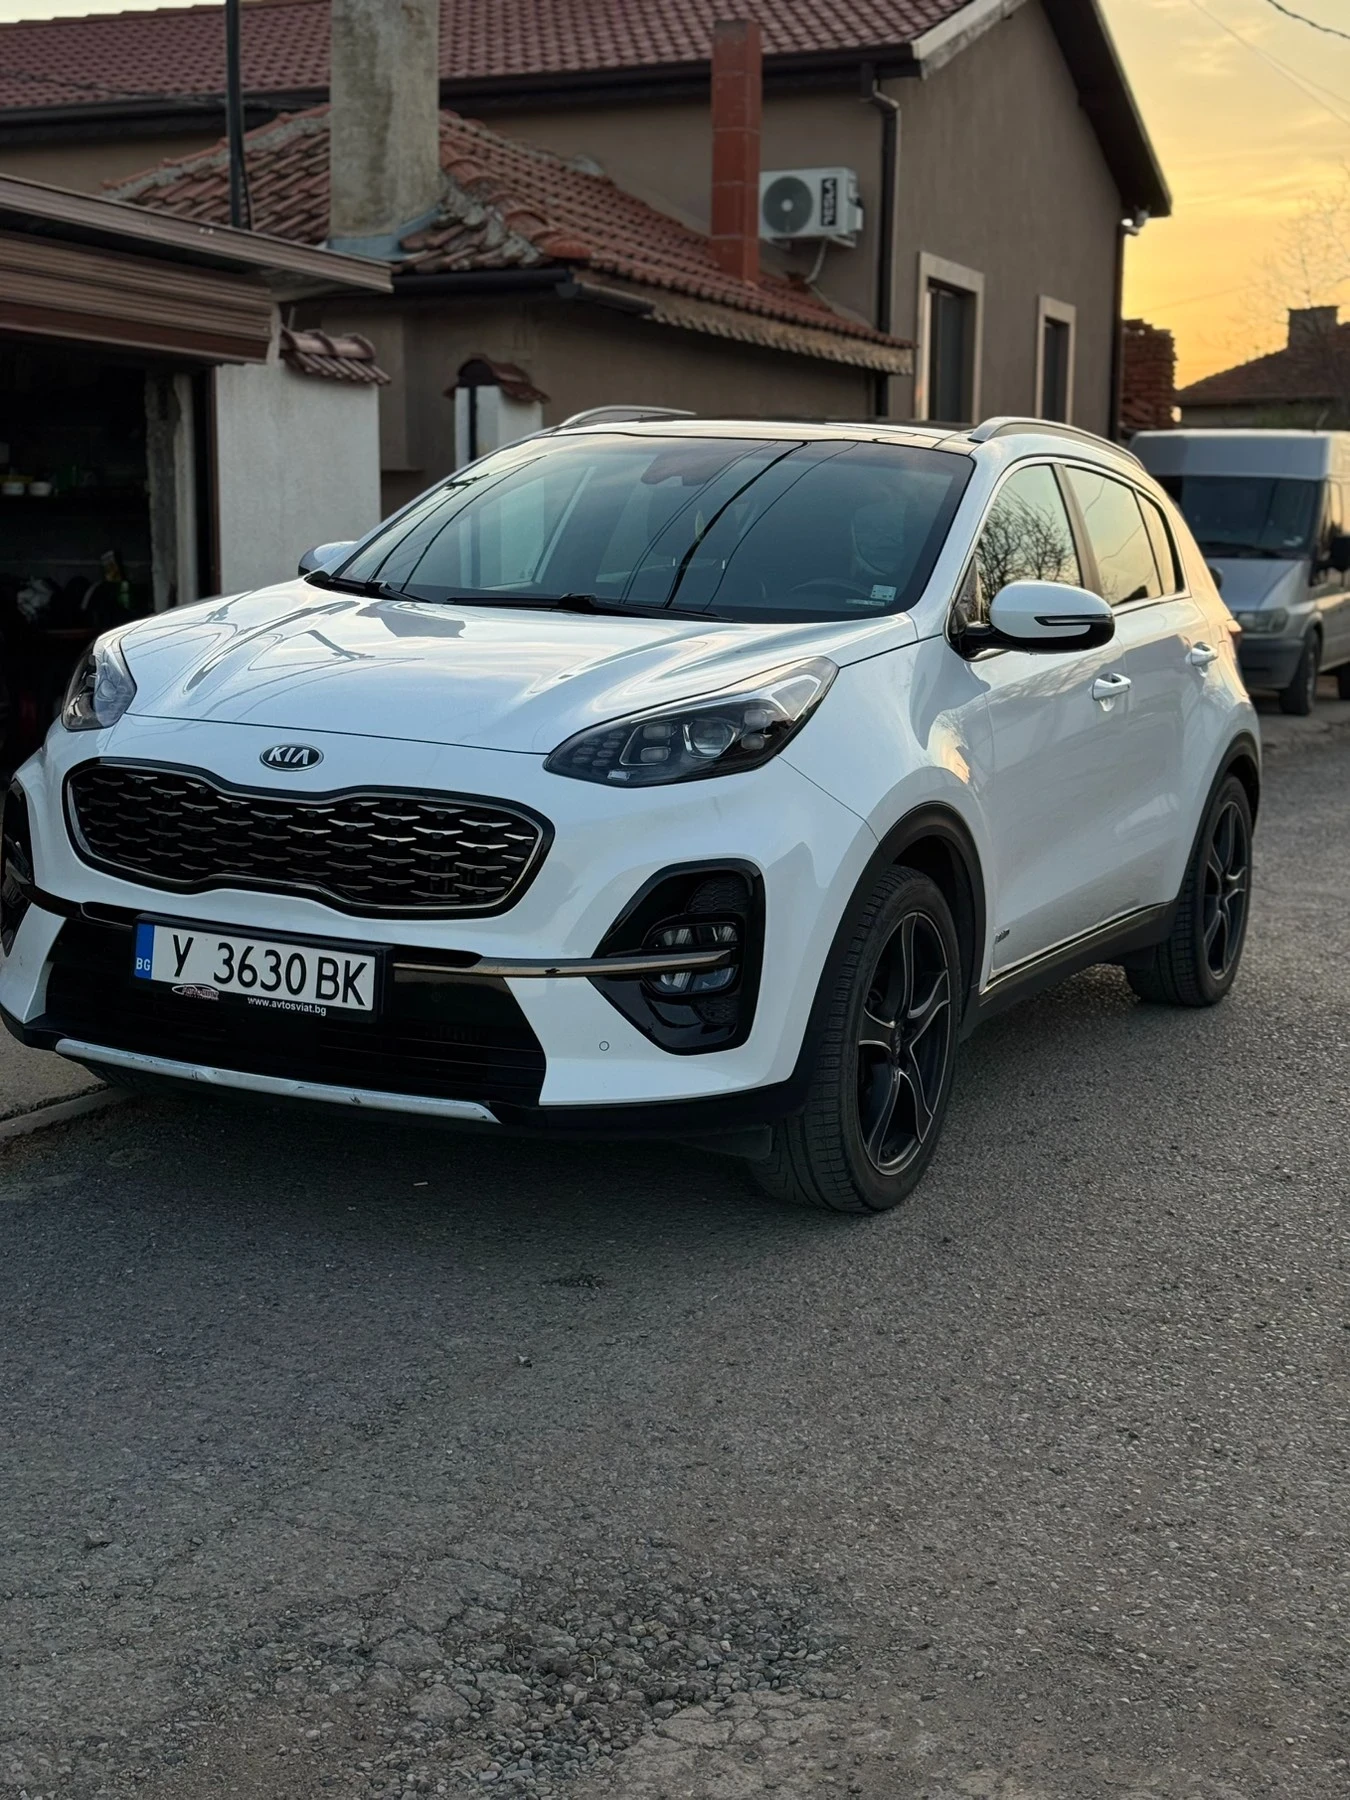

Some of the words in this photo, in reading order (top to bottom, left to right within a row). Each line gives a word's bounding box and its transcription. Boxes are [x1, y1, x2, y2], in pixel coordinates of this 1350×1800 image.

[267, 746, 310, 765] KIA
[135, 957, 151, 972] BG
[213, 942, 307, 996] 3630
[315, 955, 368, 1007] BK
[247, 996, 327, 1017] www.avtosviat.bg
